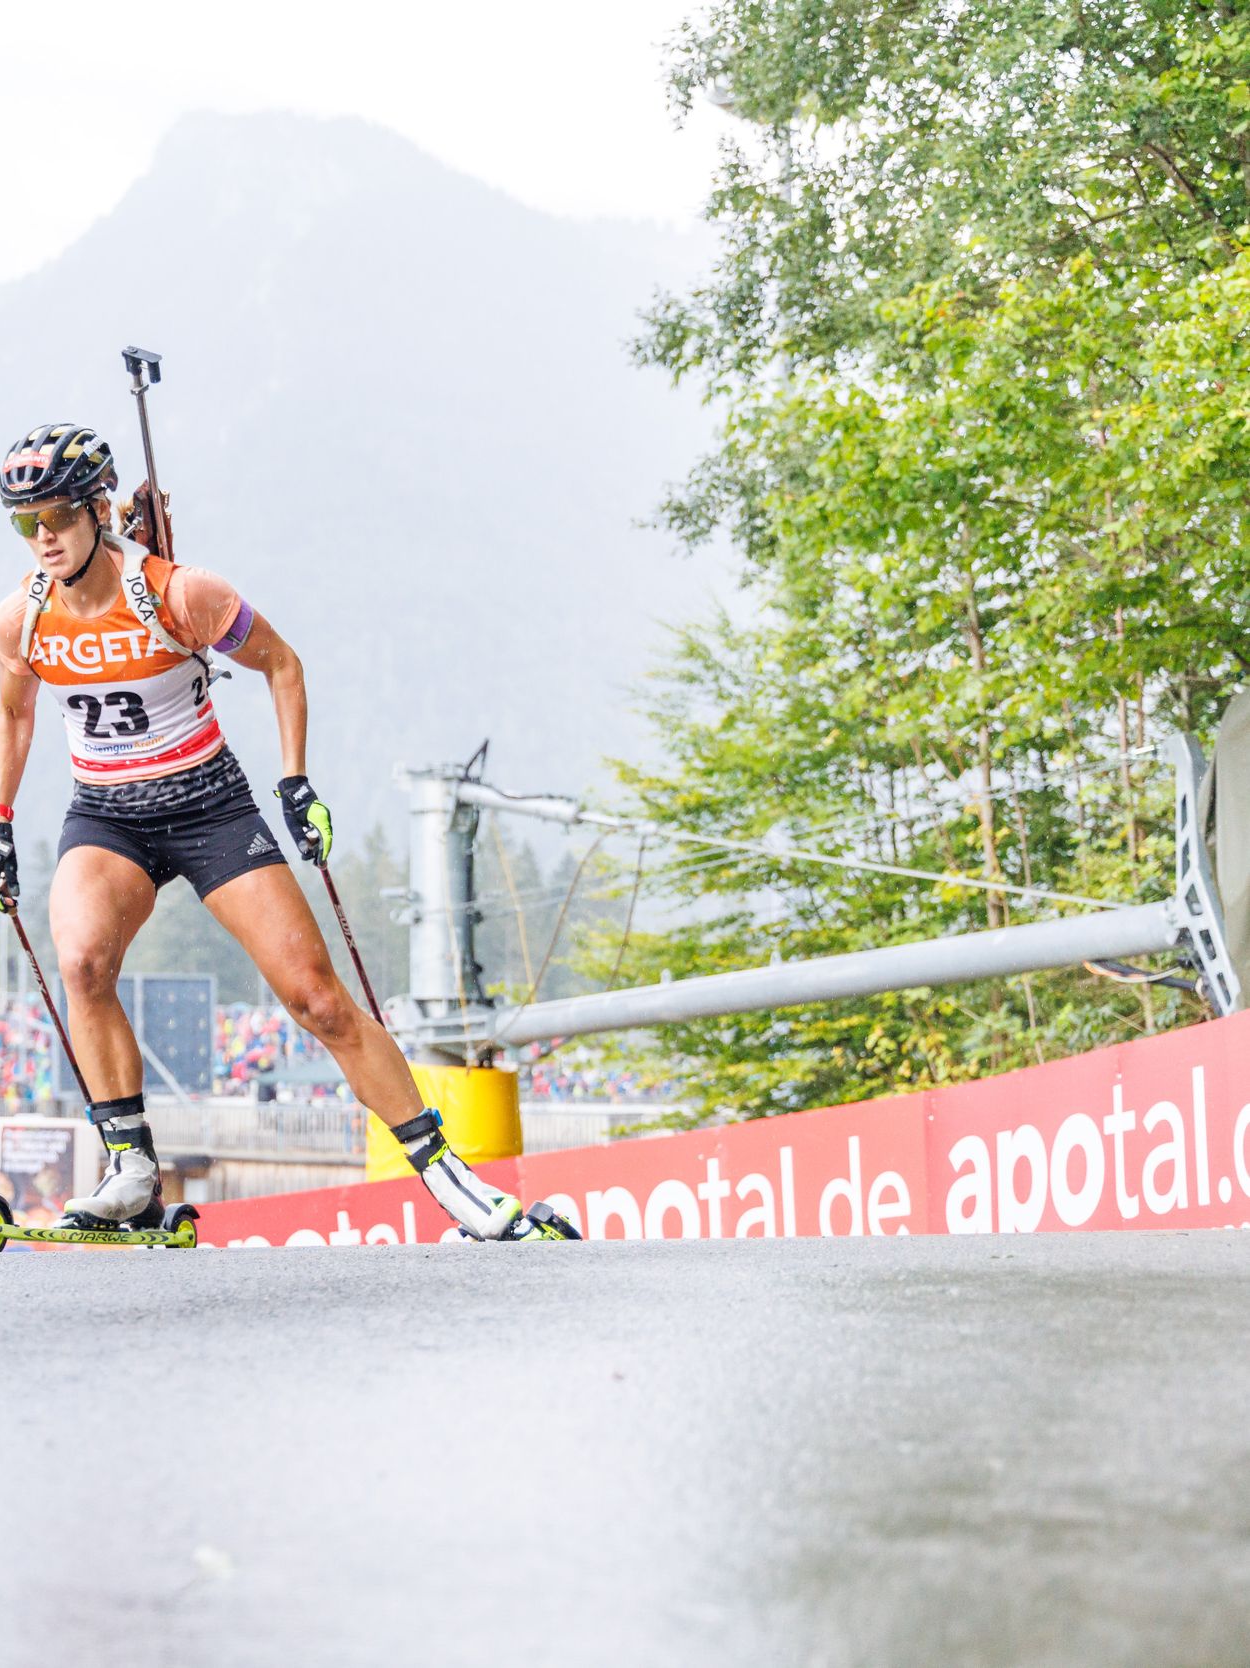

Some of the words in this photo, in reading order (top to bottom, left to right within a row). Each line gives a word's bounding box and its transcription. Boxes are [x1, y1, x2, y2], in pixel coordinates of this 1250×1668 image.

[29, 629, 175, 675] ARGETA
[67, 691, 150, 738] 23
[946, 1065, 1250, 1234] apotal.
[69, 1231, 132, 1242] MARWE
